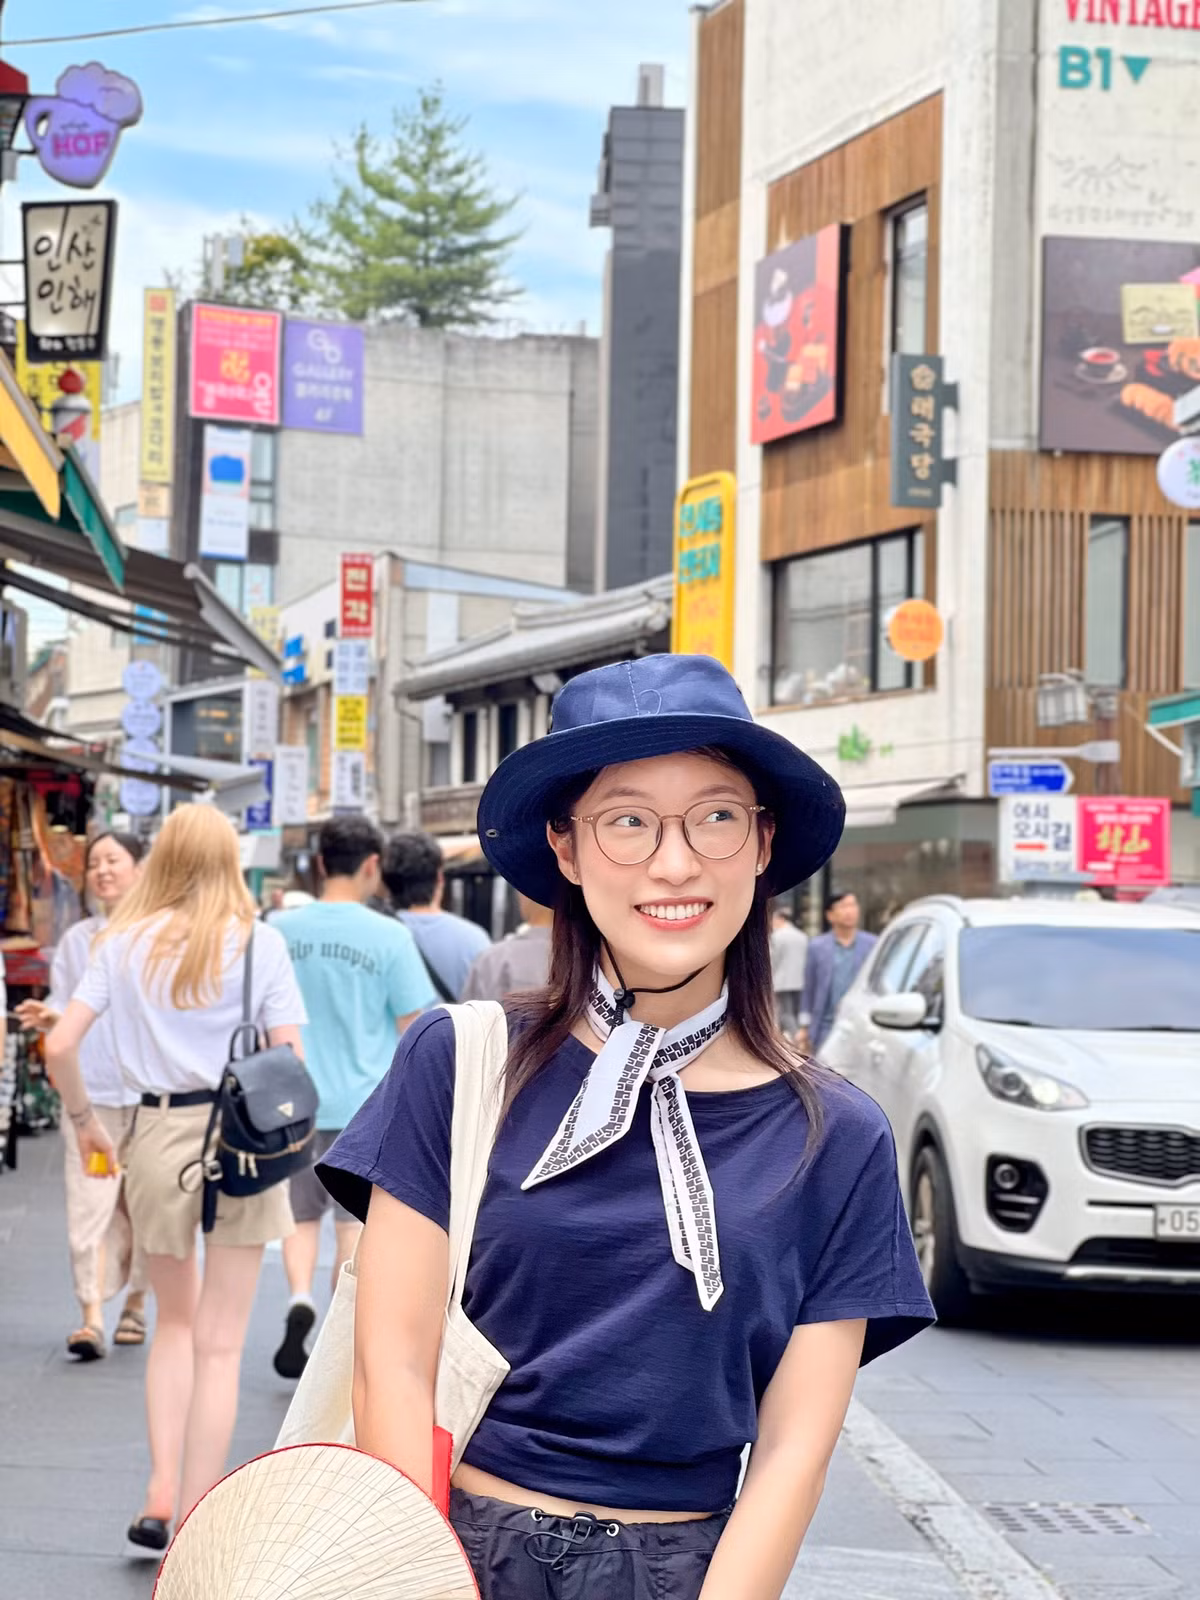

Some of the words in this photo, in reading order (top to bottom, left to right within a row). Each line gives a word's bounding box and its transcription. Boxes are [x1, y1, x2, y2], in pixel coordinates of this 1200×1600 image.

[1058, 45, 1111, 91] B1
[53, 131, 108, 159] HOF
[34, 205, 97, 271] 인산
[37, 275, 97, 333] 인해
